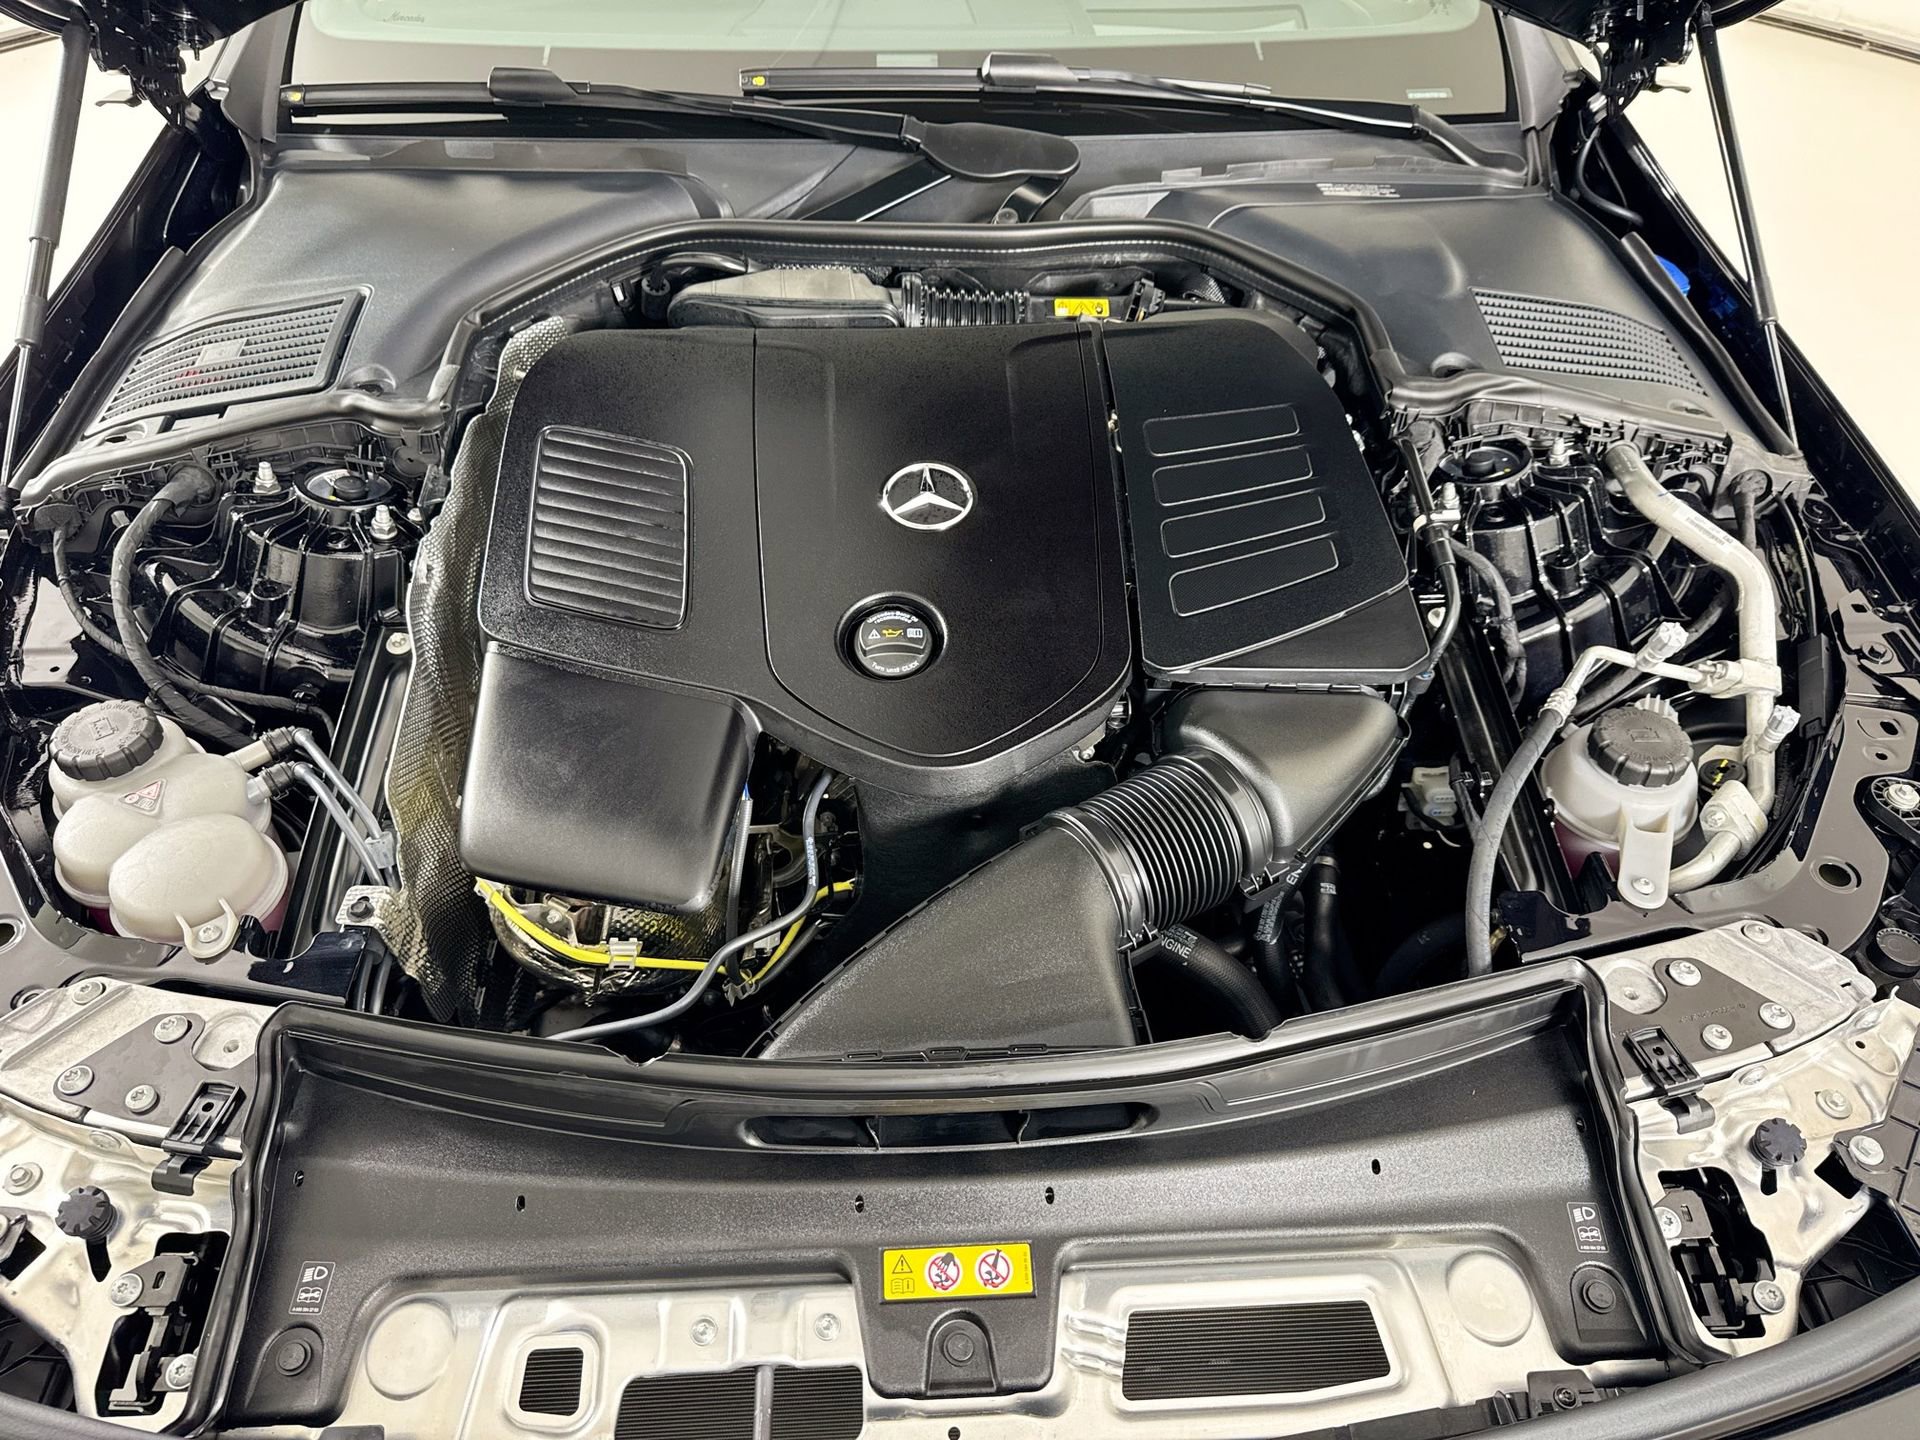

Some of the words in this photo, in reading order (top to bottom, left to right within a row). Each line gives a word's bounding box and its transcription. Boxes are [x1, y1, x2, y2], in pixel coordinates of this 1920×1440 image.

[871, 661, 885, 672] Turn
[901, 660, 920, 672] CLICK
[1160, 934, 1193, 959] NGINE
